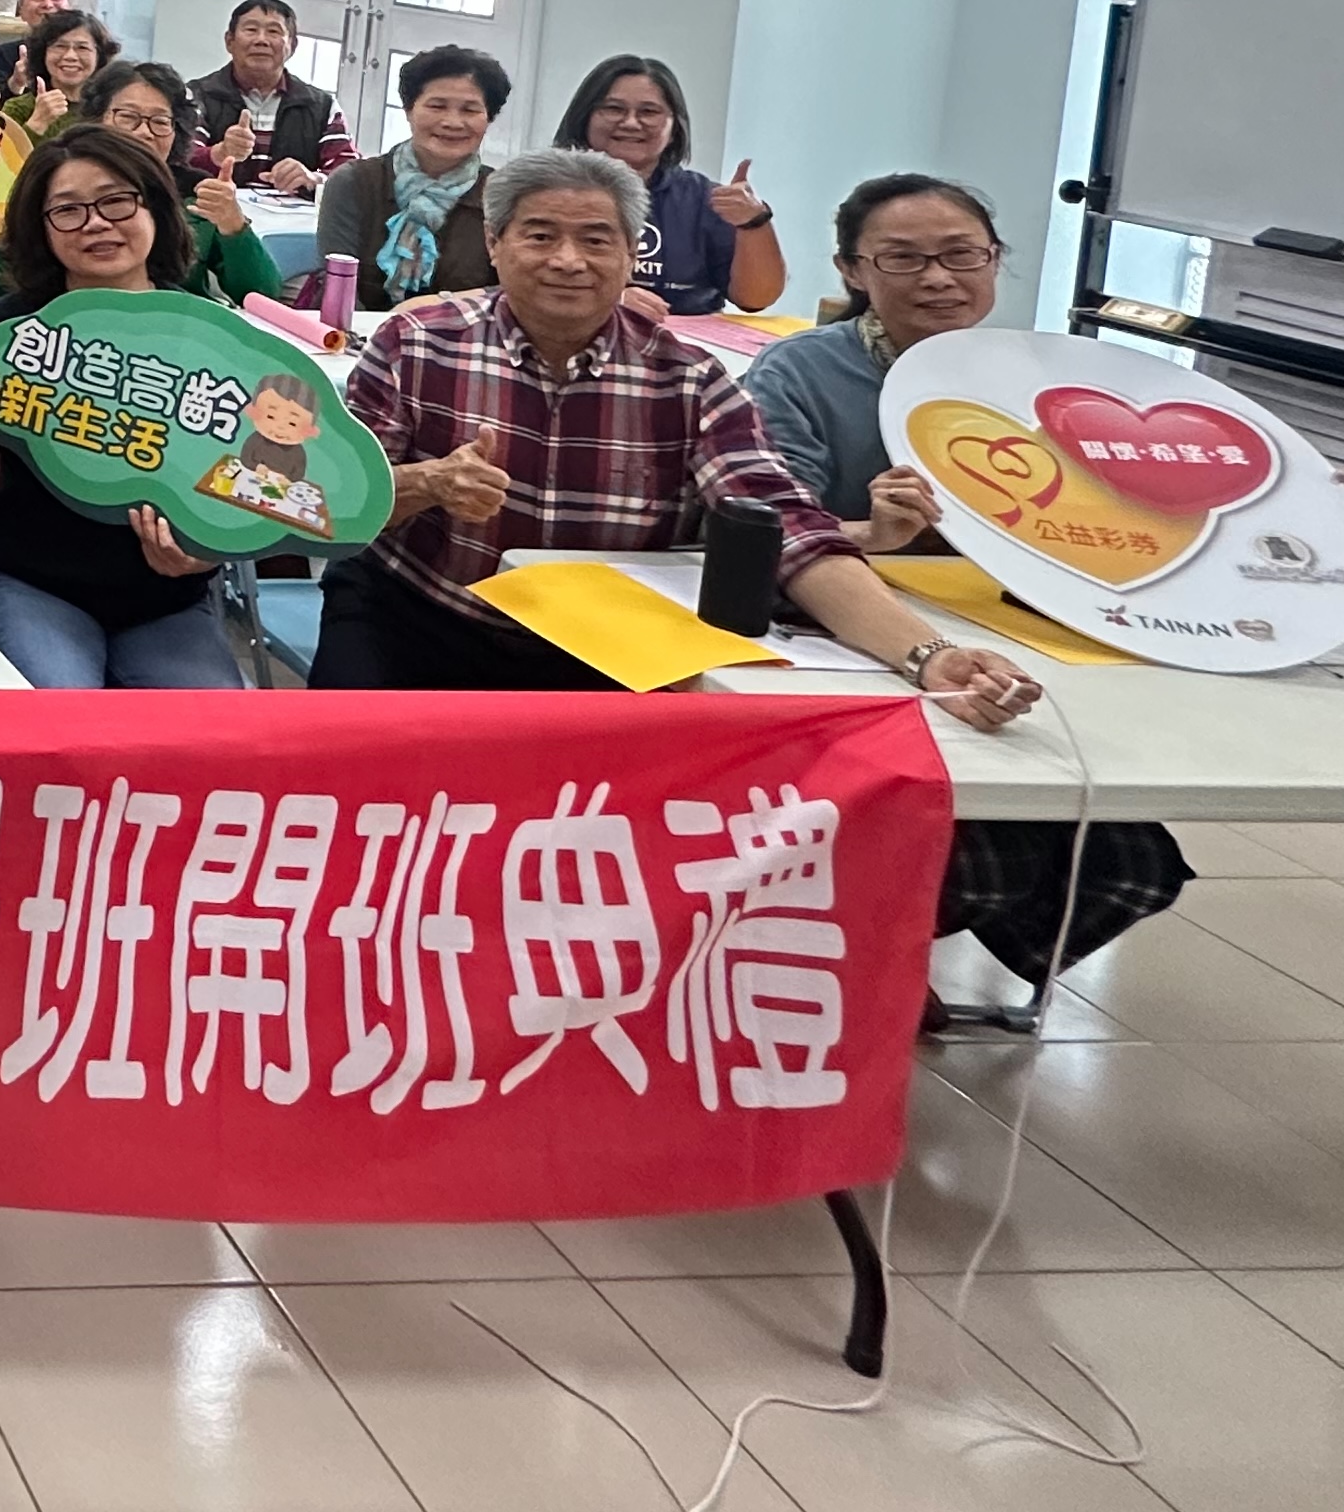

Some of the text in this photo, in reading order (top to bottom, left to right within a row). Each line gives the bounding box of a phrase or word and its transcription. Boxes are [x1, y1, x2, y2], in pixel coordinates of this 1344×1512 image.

[4, 317, 252, 441] 創造高齡
[1033, 518, 1161, 557] 公益彩券
[1134, 613, 1234, 640] TAINAN
